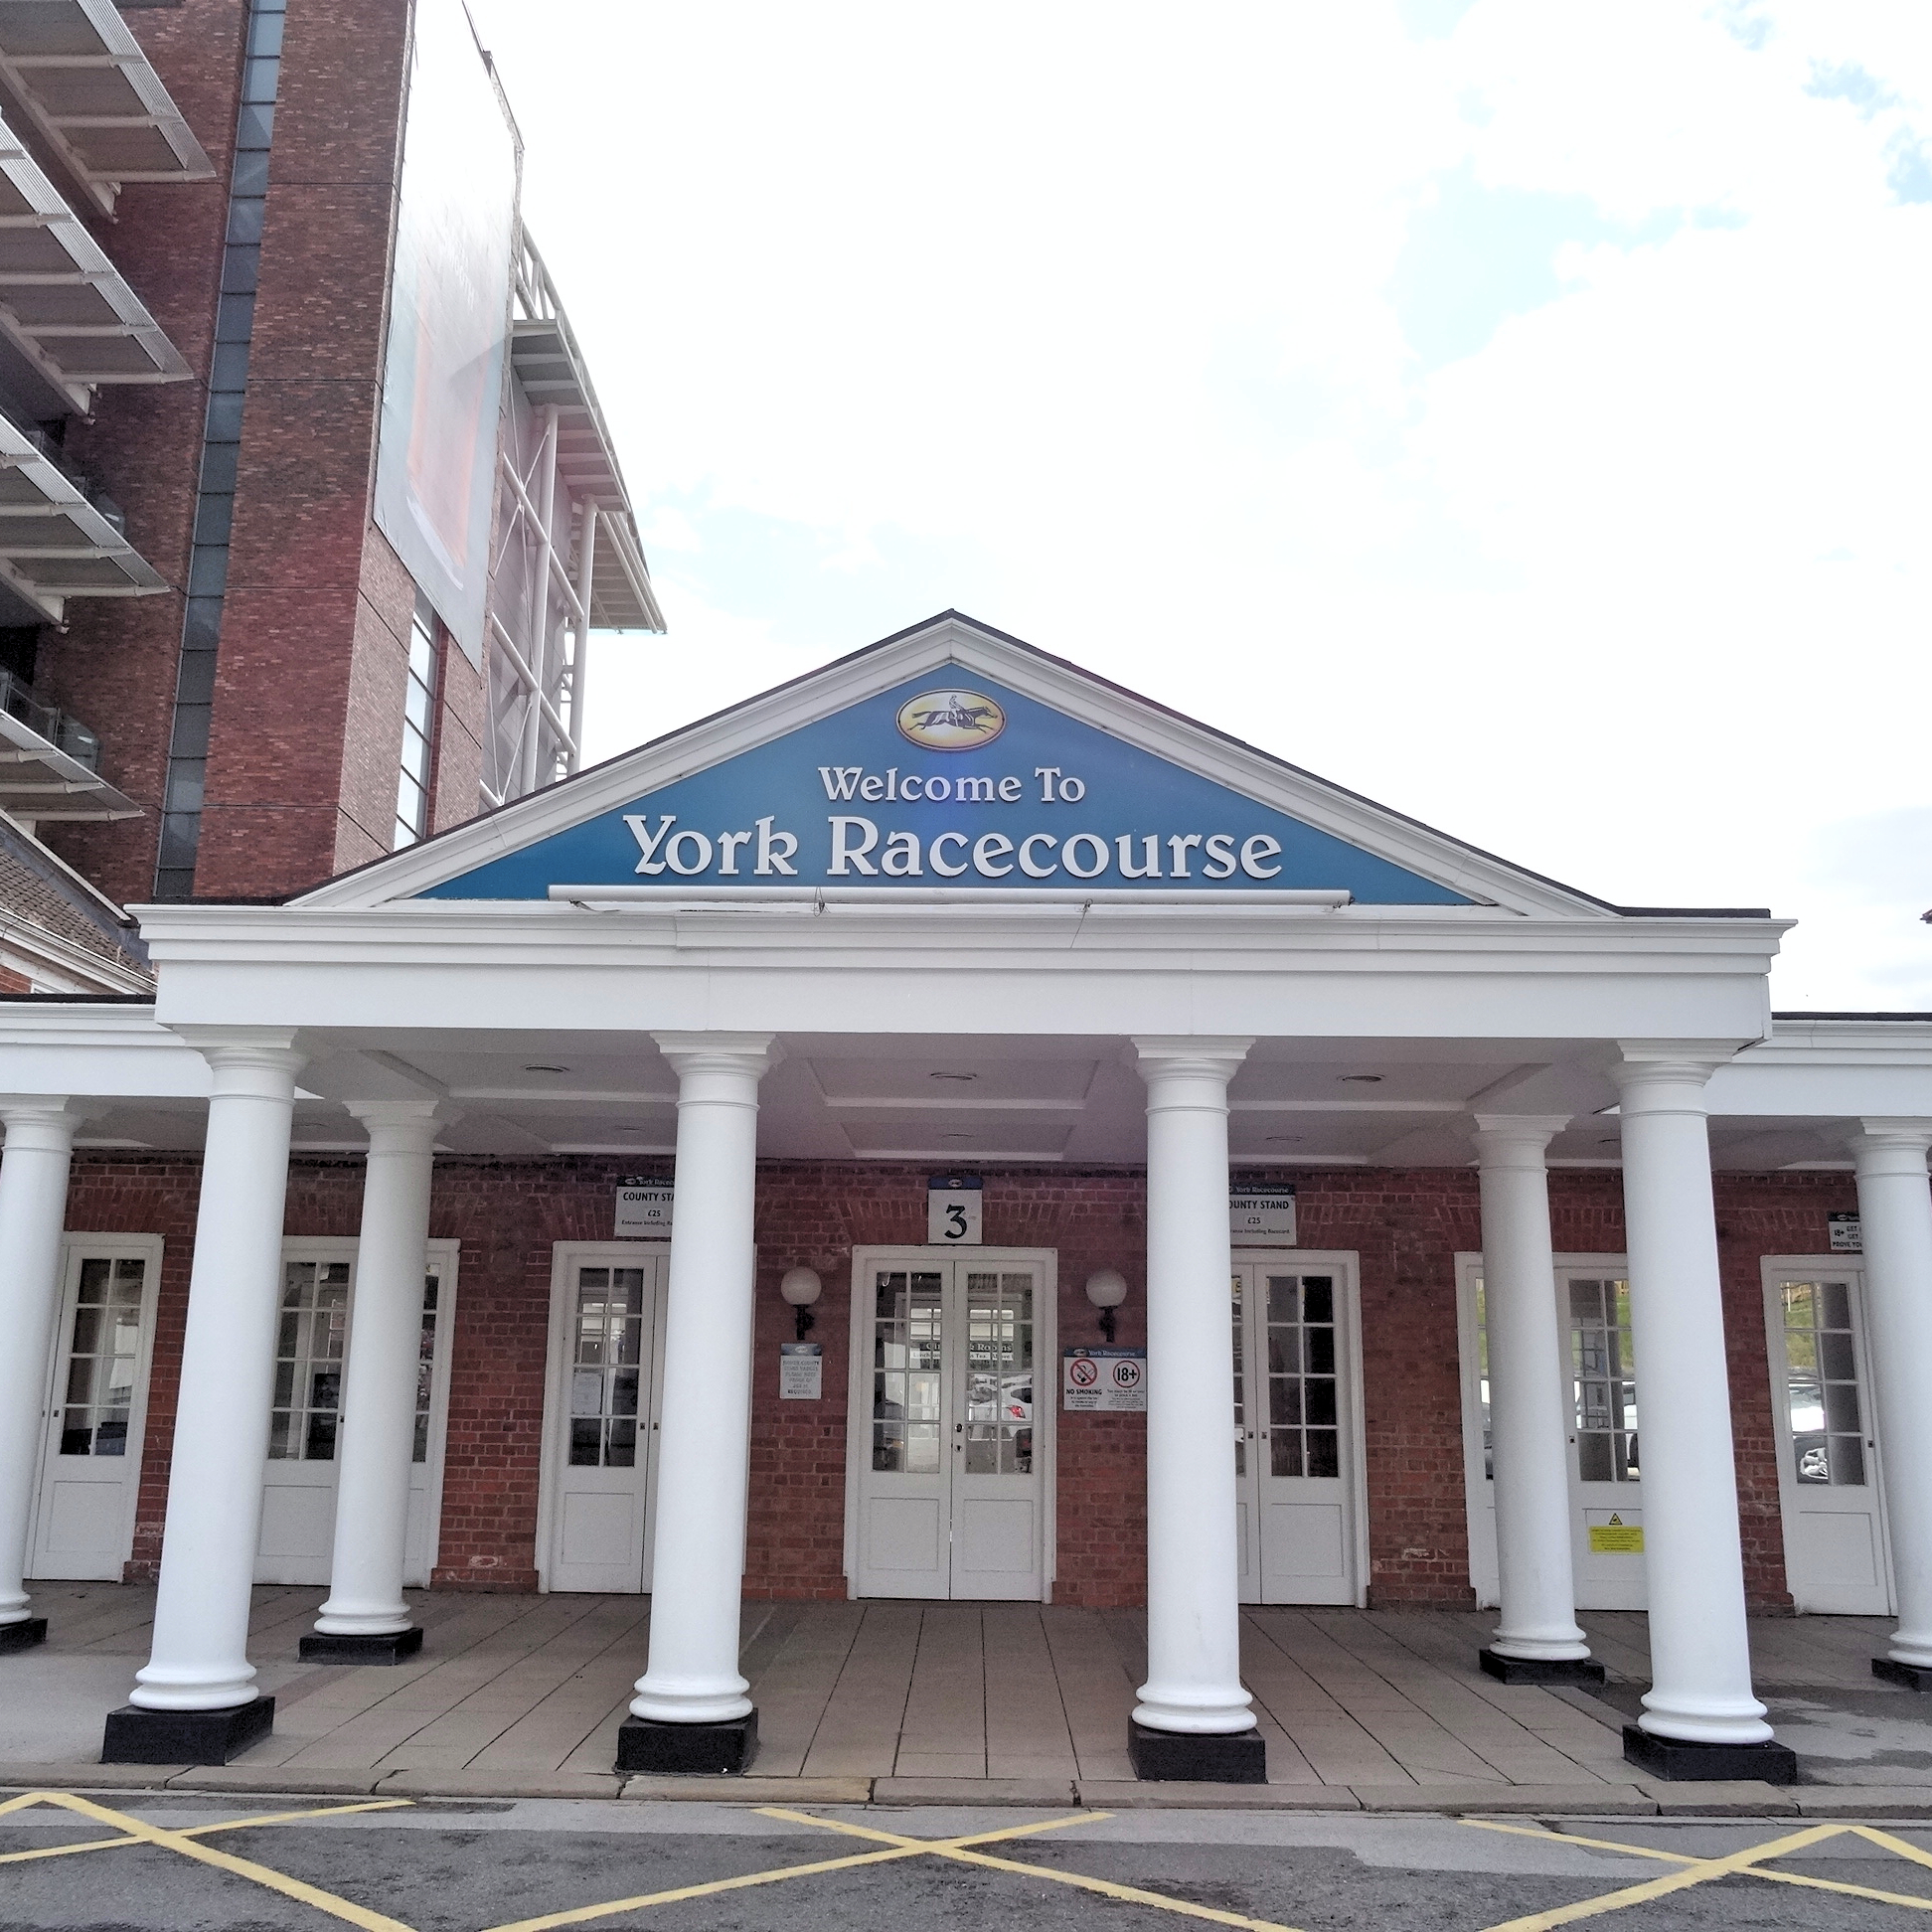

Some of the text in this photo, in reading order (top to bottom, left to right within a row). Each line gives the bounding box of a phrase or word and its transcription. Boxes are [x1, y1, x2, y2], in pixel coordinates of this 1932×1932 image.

[818, 766, 1086, 803] Welcome To
[623, 815, 1282, 880] York Racecourse
[623, 1192, 674, 1202] COUNTY STA
[1229, 1200, 1289, 1209] OUNTY STAND
[944, 1204, 967, 1239] 3
[1117, 1367, 1137, 1381] 18+
